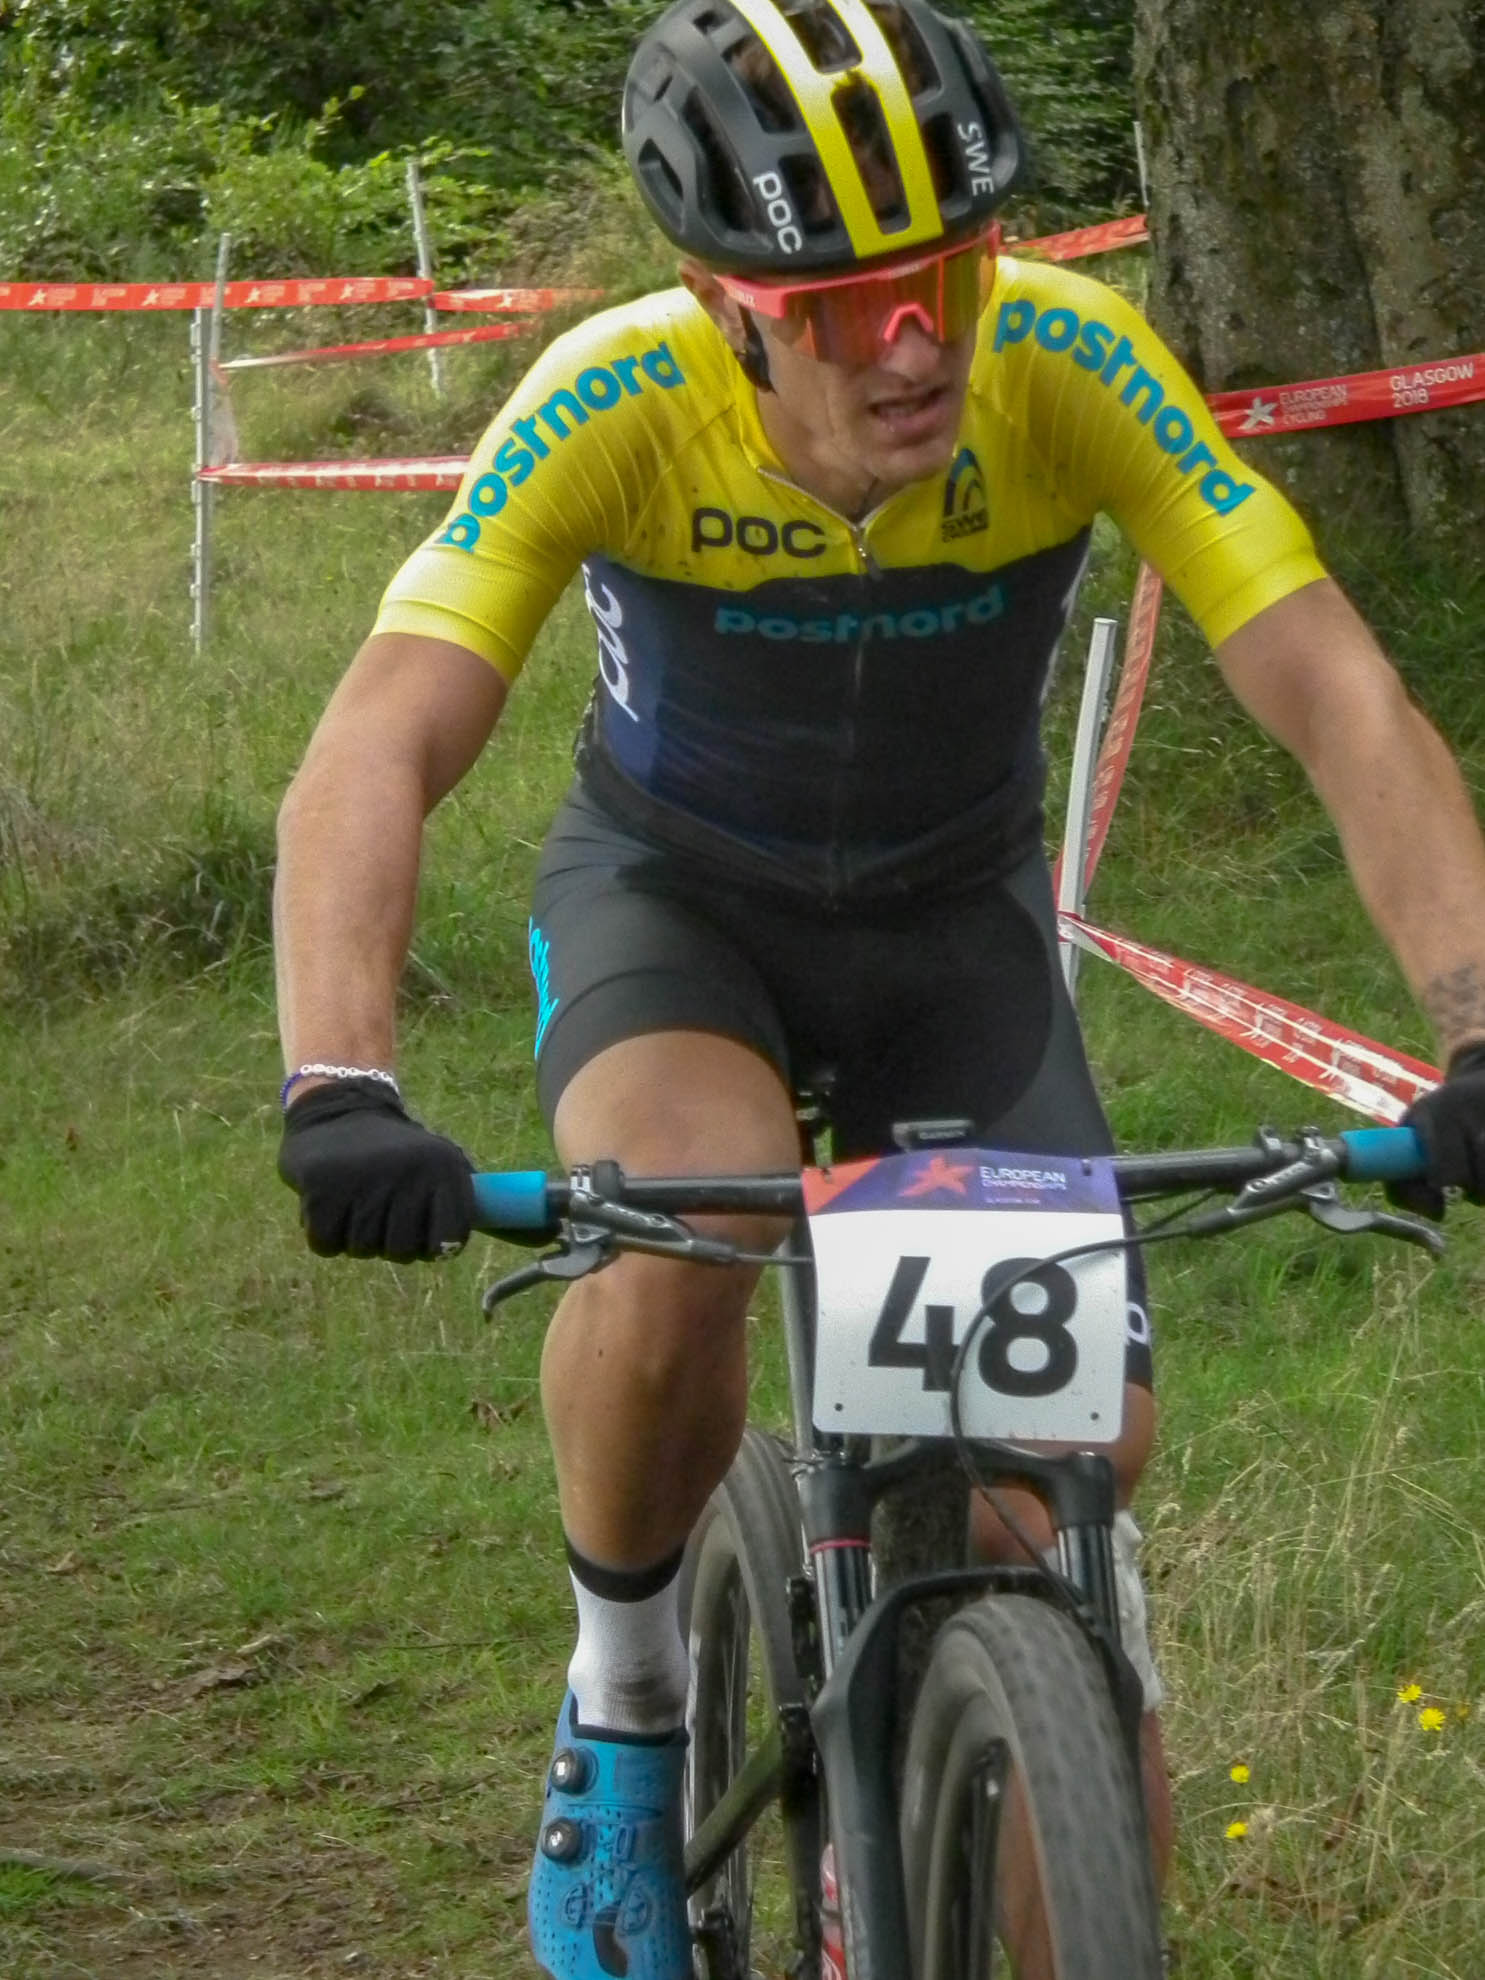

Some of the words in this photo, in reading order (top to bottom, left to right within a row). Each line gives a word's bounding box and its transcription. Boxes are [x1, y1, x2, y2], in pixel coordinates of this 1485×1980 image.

[957, 121, 995, 196] SWE
[993, 298, 1256, 517] postnord
[1390, 362, 1474, 391] GLASGOW
[1392, 388, 1429, 408] 2018
[435, 341, 686, 553] postnord
[714, 583, 1004, 643] postnord
[980, 1166, 1066, 1183] EUROPEAN
[868, 1255, 1078, 1397] 48
